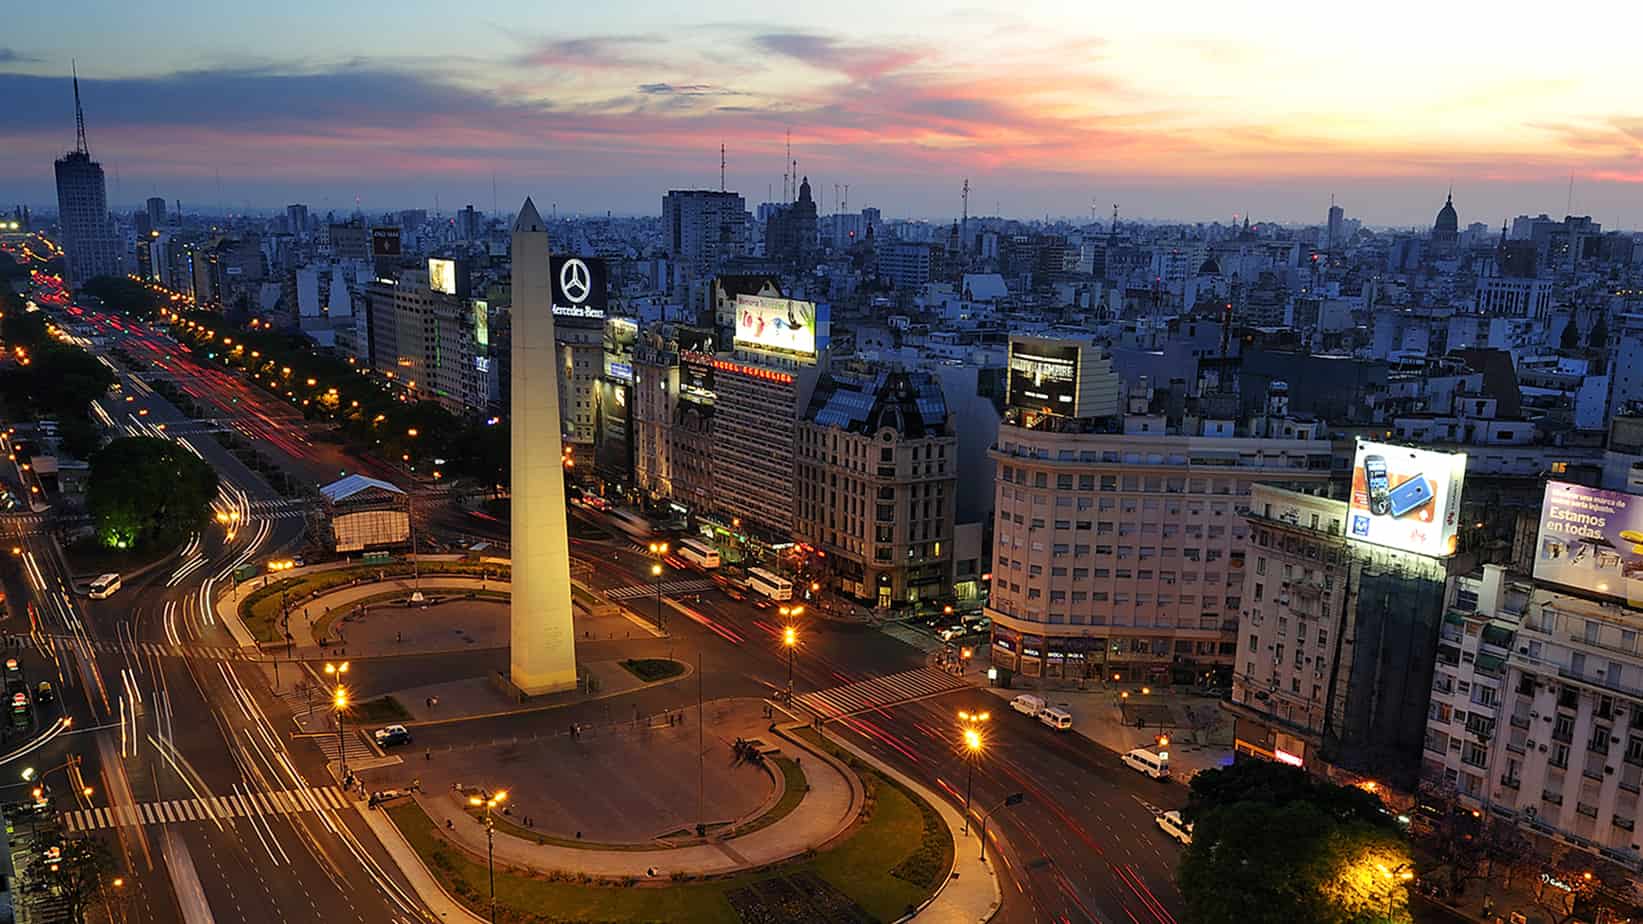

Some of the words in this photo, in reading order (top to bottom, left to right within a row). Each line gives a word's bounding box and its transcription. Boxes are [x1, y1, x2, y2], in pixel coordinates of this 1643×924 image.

[710, 360, 739, 373] HOTEL
[1550, 506, 1606, 527] Estamos
[1546, 520, 1563, 532] en
[1565, 522, 1605, 540] todas.
